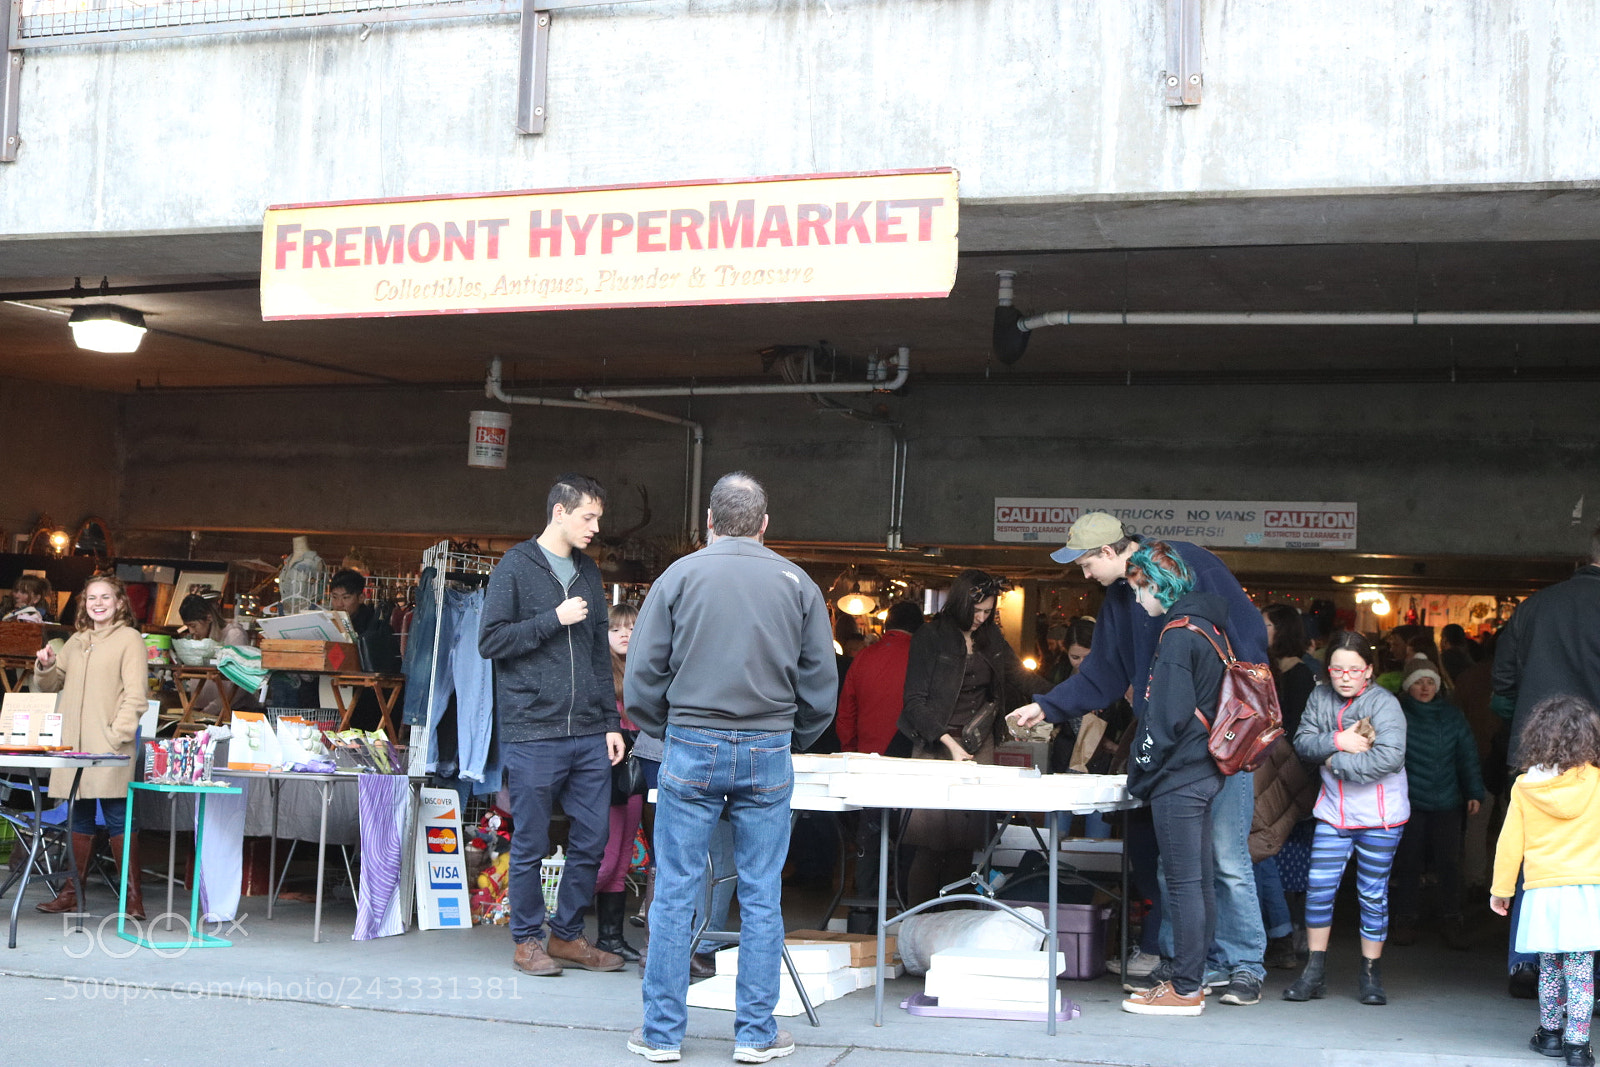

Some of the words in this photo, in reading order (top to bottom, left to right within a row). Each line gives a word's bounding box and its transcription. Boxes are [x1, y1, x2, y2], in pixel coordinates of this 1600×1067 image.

[275, 218, 510, 270] FREMONT
[529, 197, 944, 258] HYPERMARKET
[374, 276, 488, 301] Collectibles,
[489, 273, 589, 299] Antiques,
[595, 267, 681, 292] Plunder
[688, 266, 706, 288] &
[714, 264, 814, 287] Treasure
[997, 507, 1078, 522] CAUTION
[1113, 508, 1174, 520] TRUCKS
[1187, 509, 1210, 521] NO
[1215, 510, 1256, 522] VANS
[1264, 511, 1354, 529] CAUTION
[996, 525, 1030, 533] RESTRICTED
[1032, 525, 1066, 533] CLEARANCE
[1142, 525, 1225, 537] CAMPERS!!
[1264, 530, 1300, 538] RESTRICTED
[1302, 531, 1340, 539] CLEARANCE
[424, 797, 452, 806] DISCOVER
[432, 866, 459, 879] VISA
